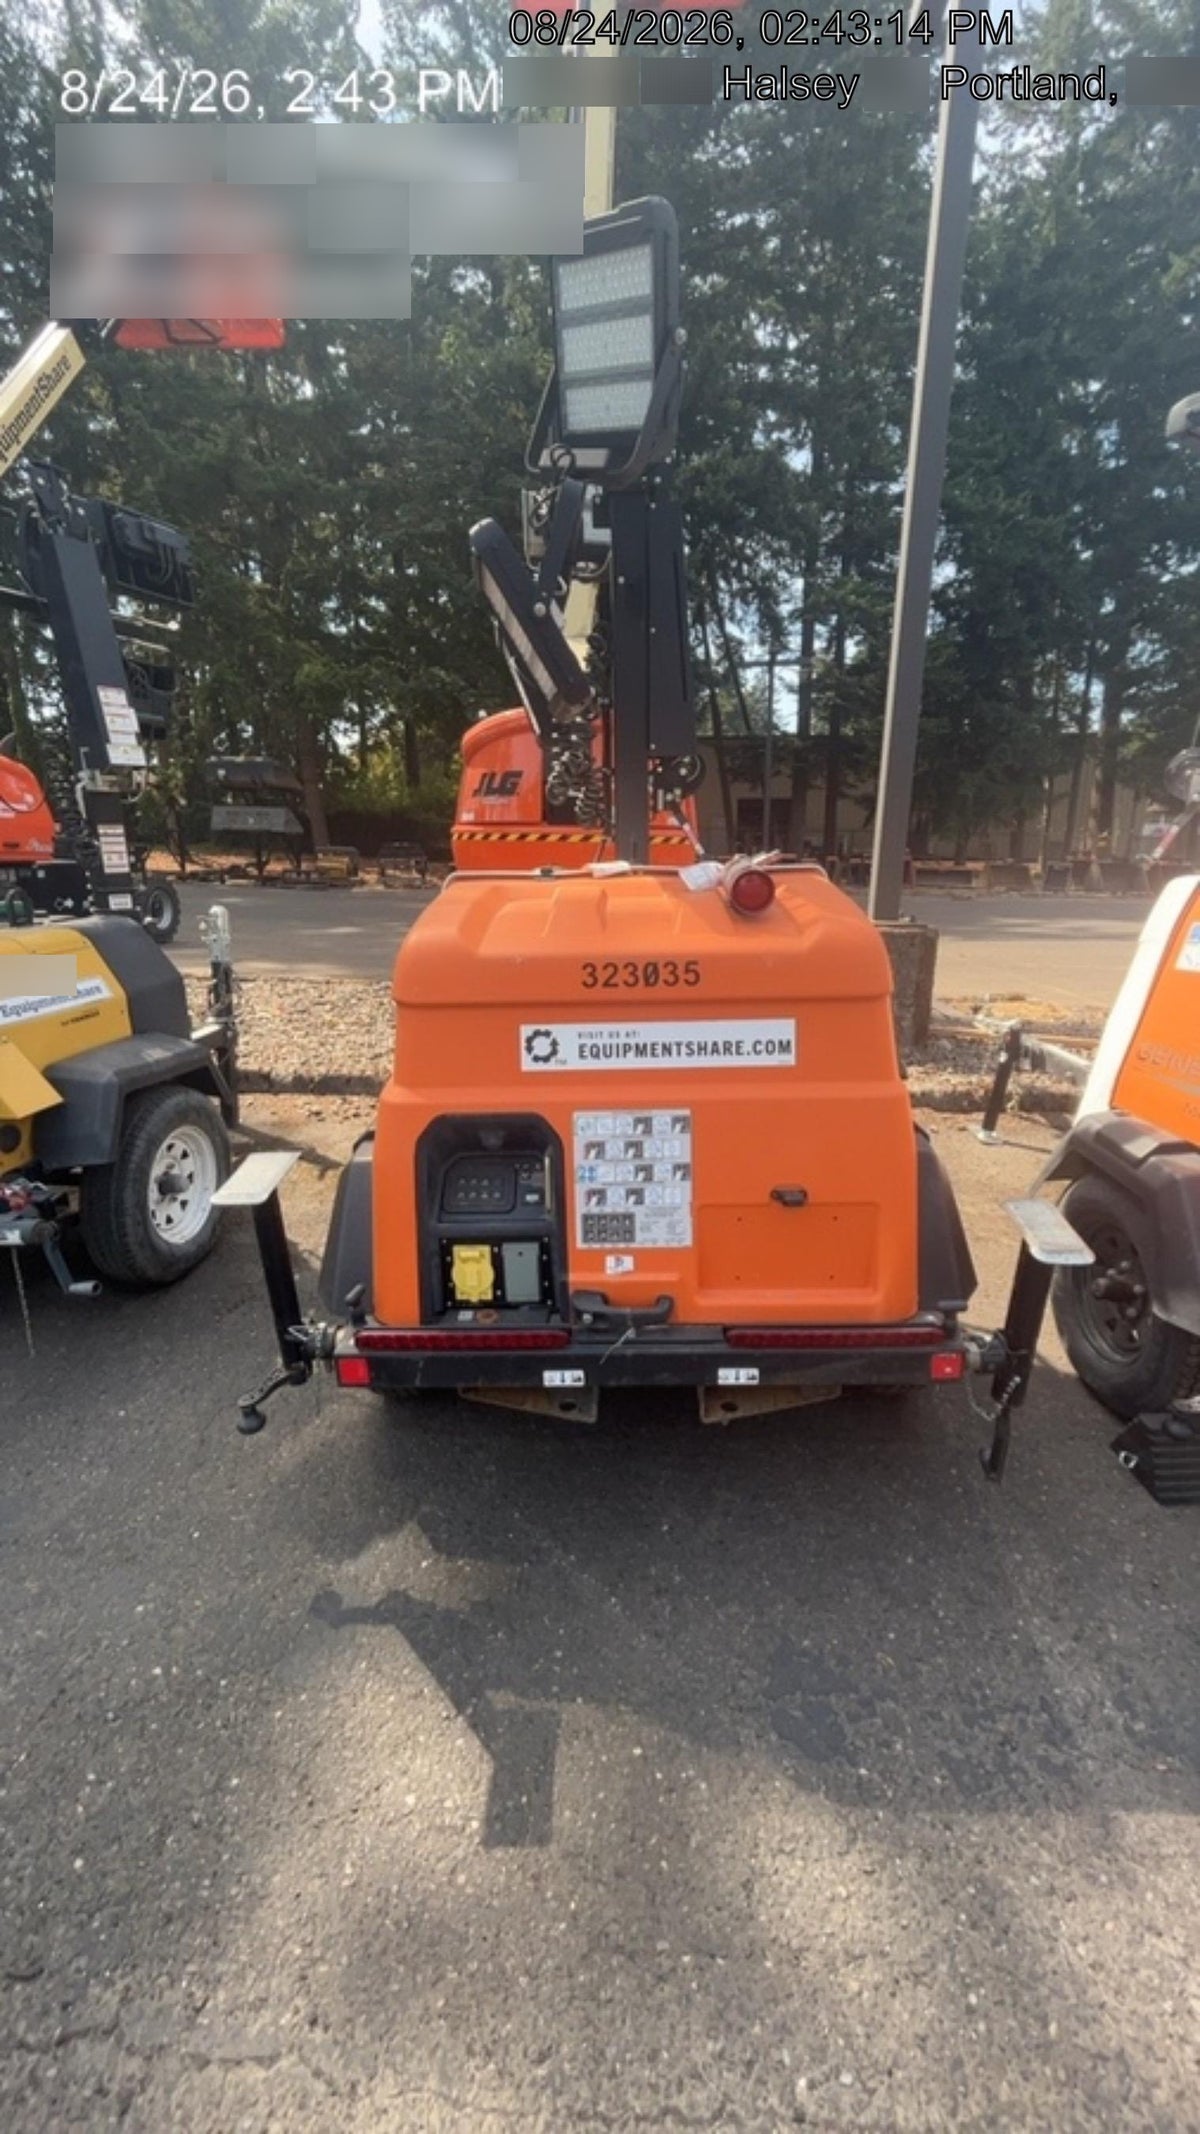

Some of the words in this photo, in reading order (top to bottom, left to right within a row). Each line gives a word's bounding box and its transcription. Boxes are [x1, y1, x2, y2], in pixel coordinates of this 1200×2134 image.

[472, 770, 524, 797] JLG
[581, 960, 701, 989] 323035
[578, 1039, 792, 1060] EQUIPMENTSHARE.COM
